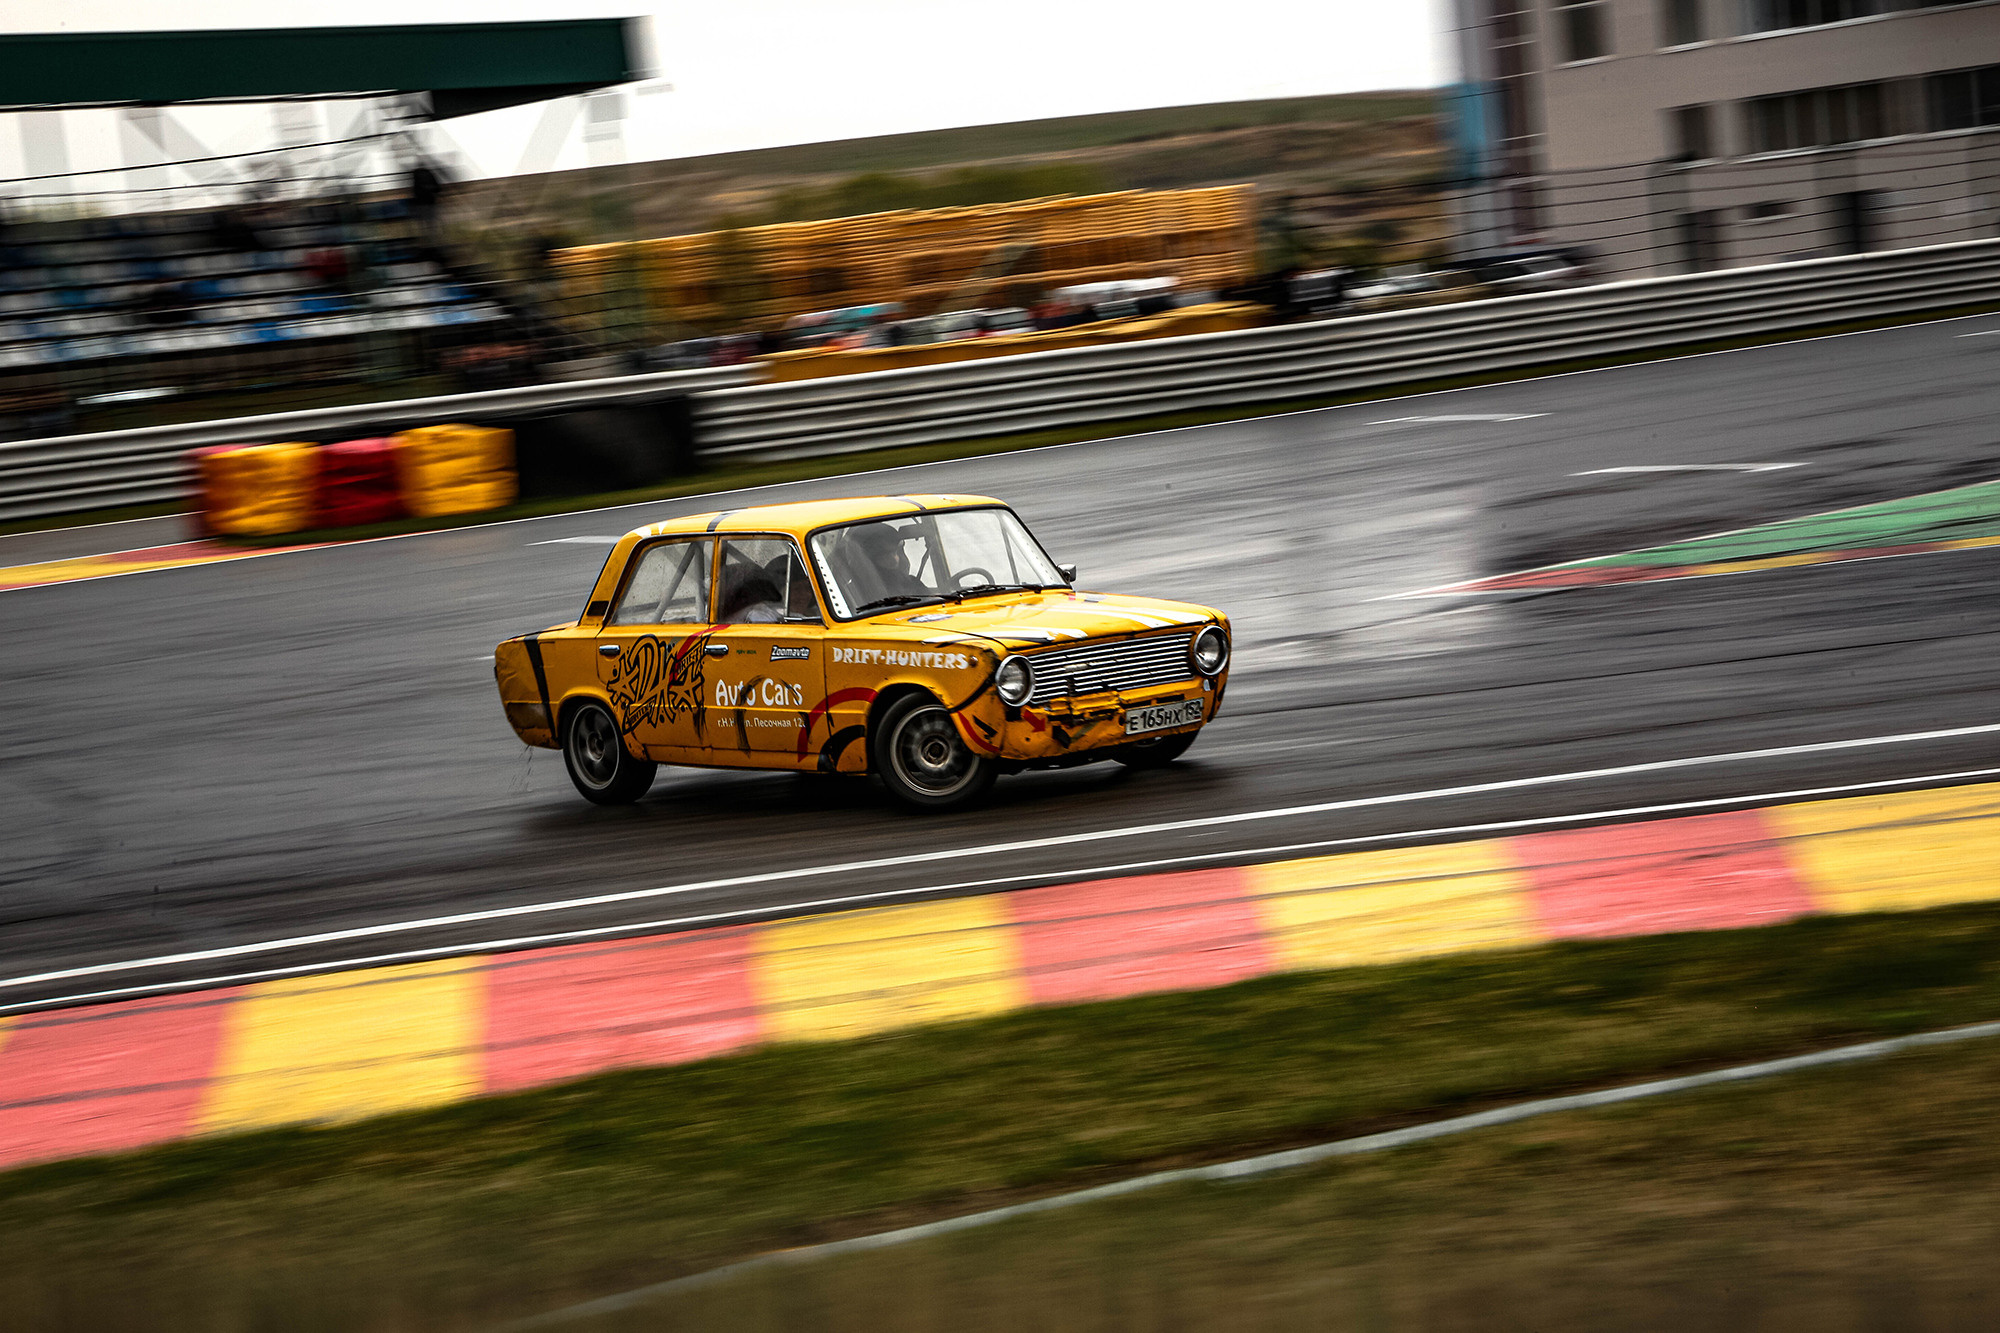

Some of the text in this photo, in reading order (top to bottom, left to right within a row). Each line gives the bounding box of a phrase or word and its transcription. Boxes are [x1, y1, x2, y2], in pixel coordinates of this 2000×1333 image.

[772, 646, 810, 657] Zoomavto
[832, 647, 969, 669] DRIFT-HUNTERS
[762, 678, 803, 706] Cars
[753, 717, 792, 728] Песочная
